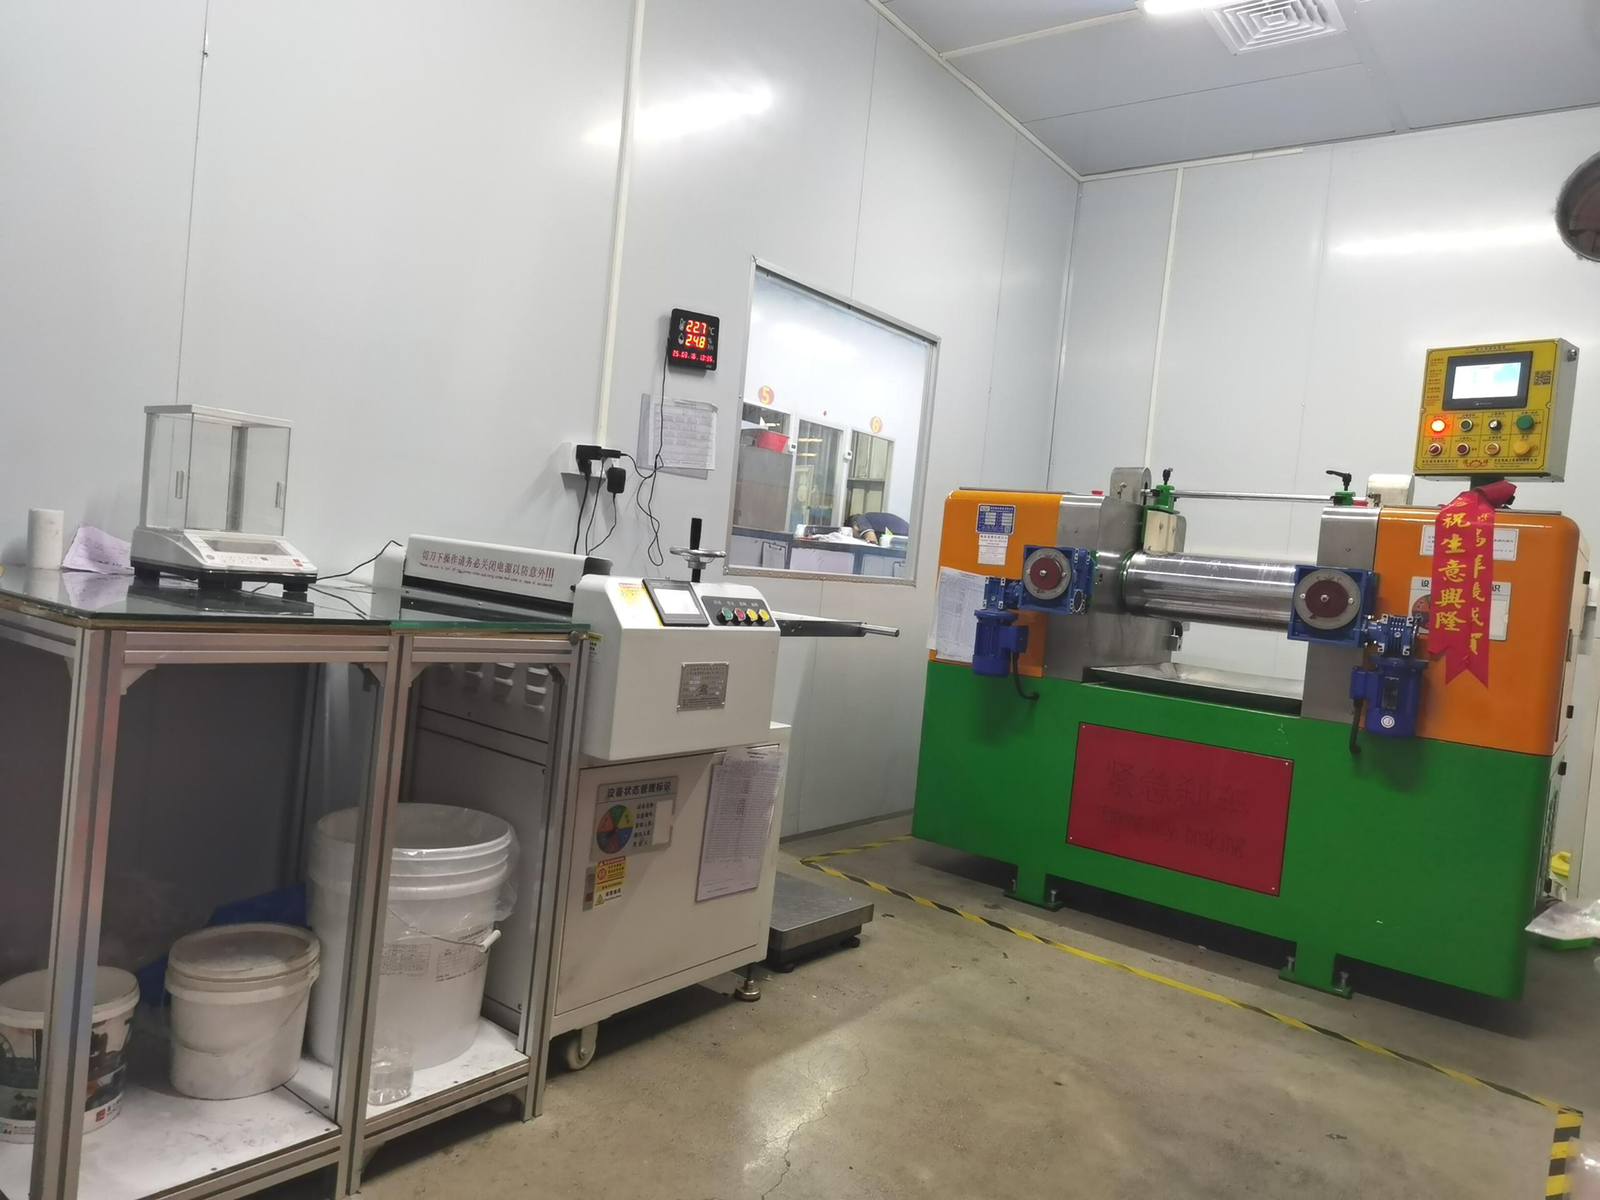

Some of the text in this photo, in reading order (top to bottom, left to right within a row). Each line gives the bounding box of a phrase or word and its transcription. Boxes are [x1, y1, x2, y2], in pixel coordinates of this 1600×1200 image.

[760, 386, 771, 405] 5
[871, 418, 880, 433] 6
[607, 781, 671, 798] 设备状态管理标识
[1105, 759, 1250, 816] 紧急刹车
[1101, 804, 1246, 860] Emergency braking
